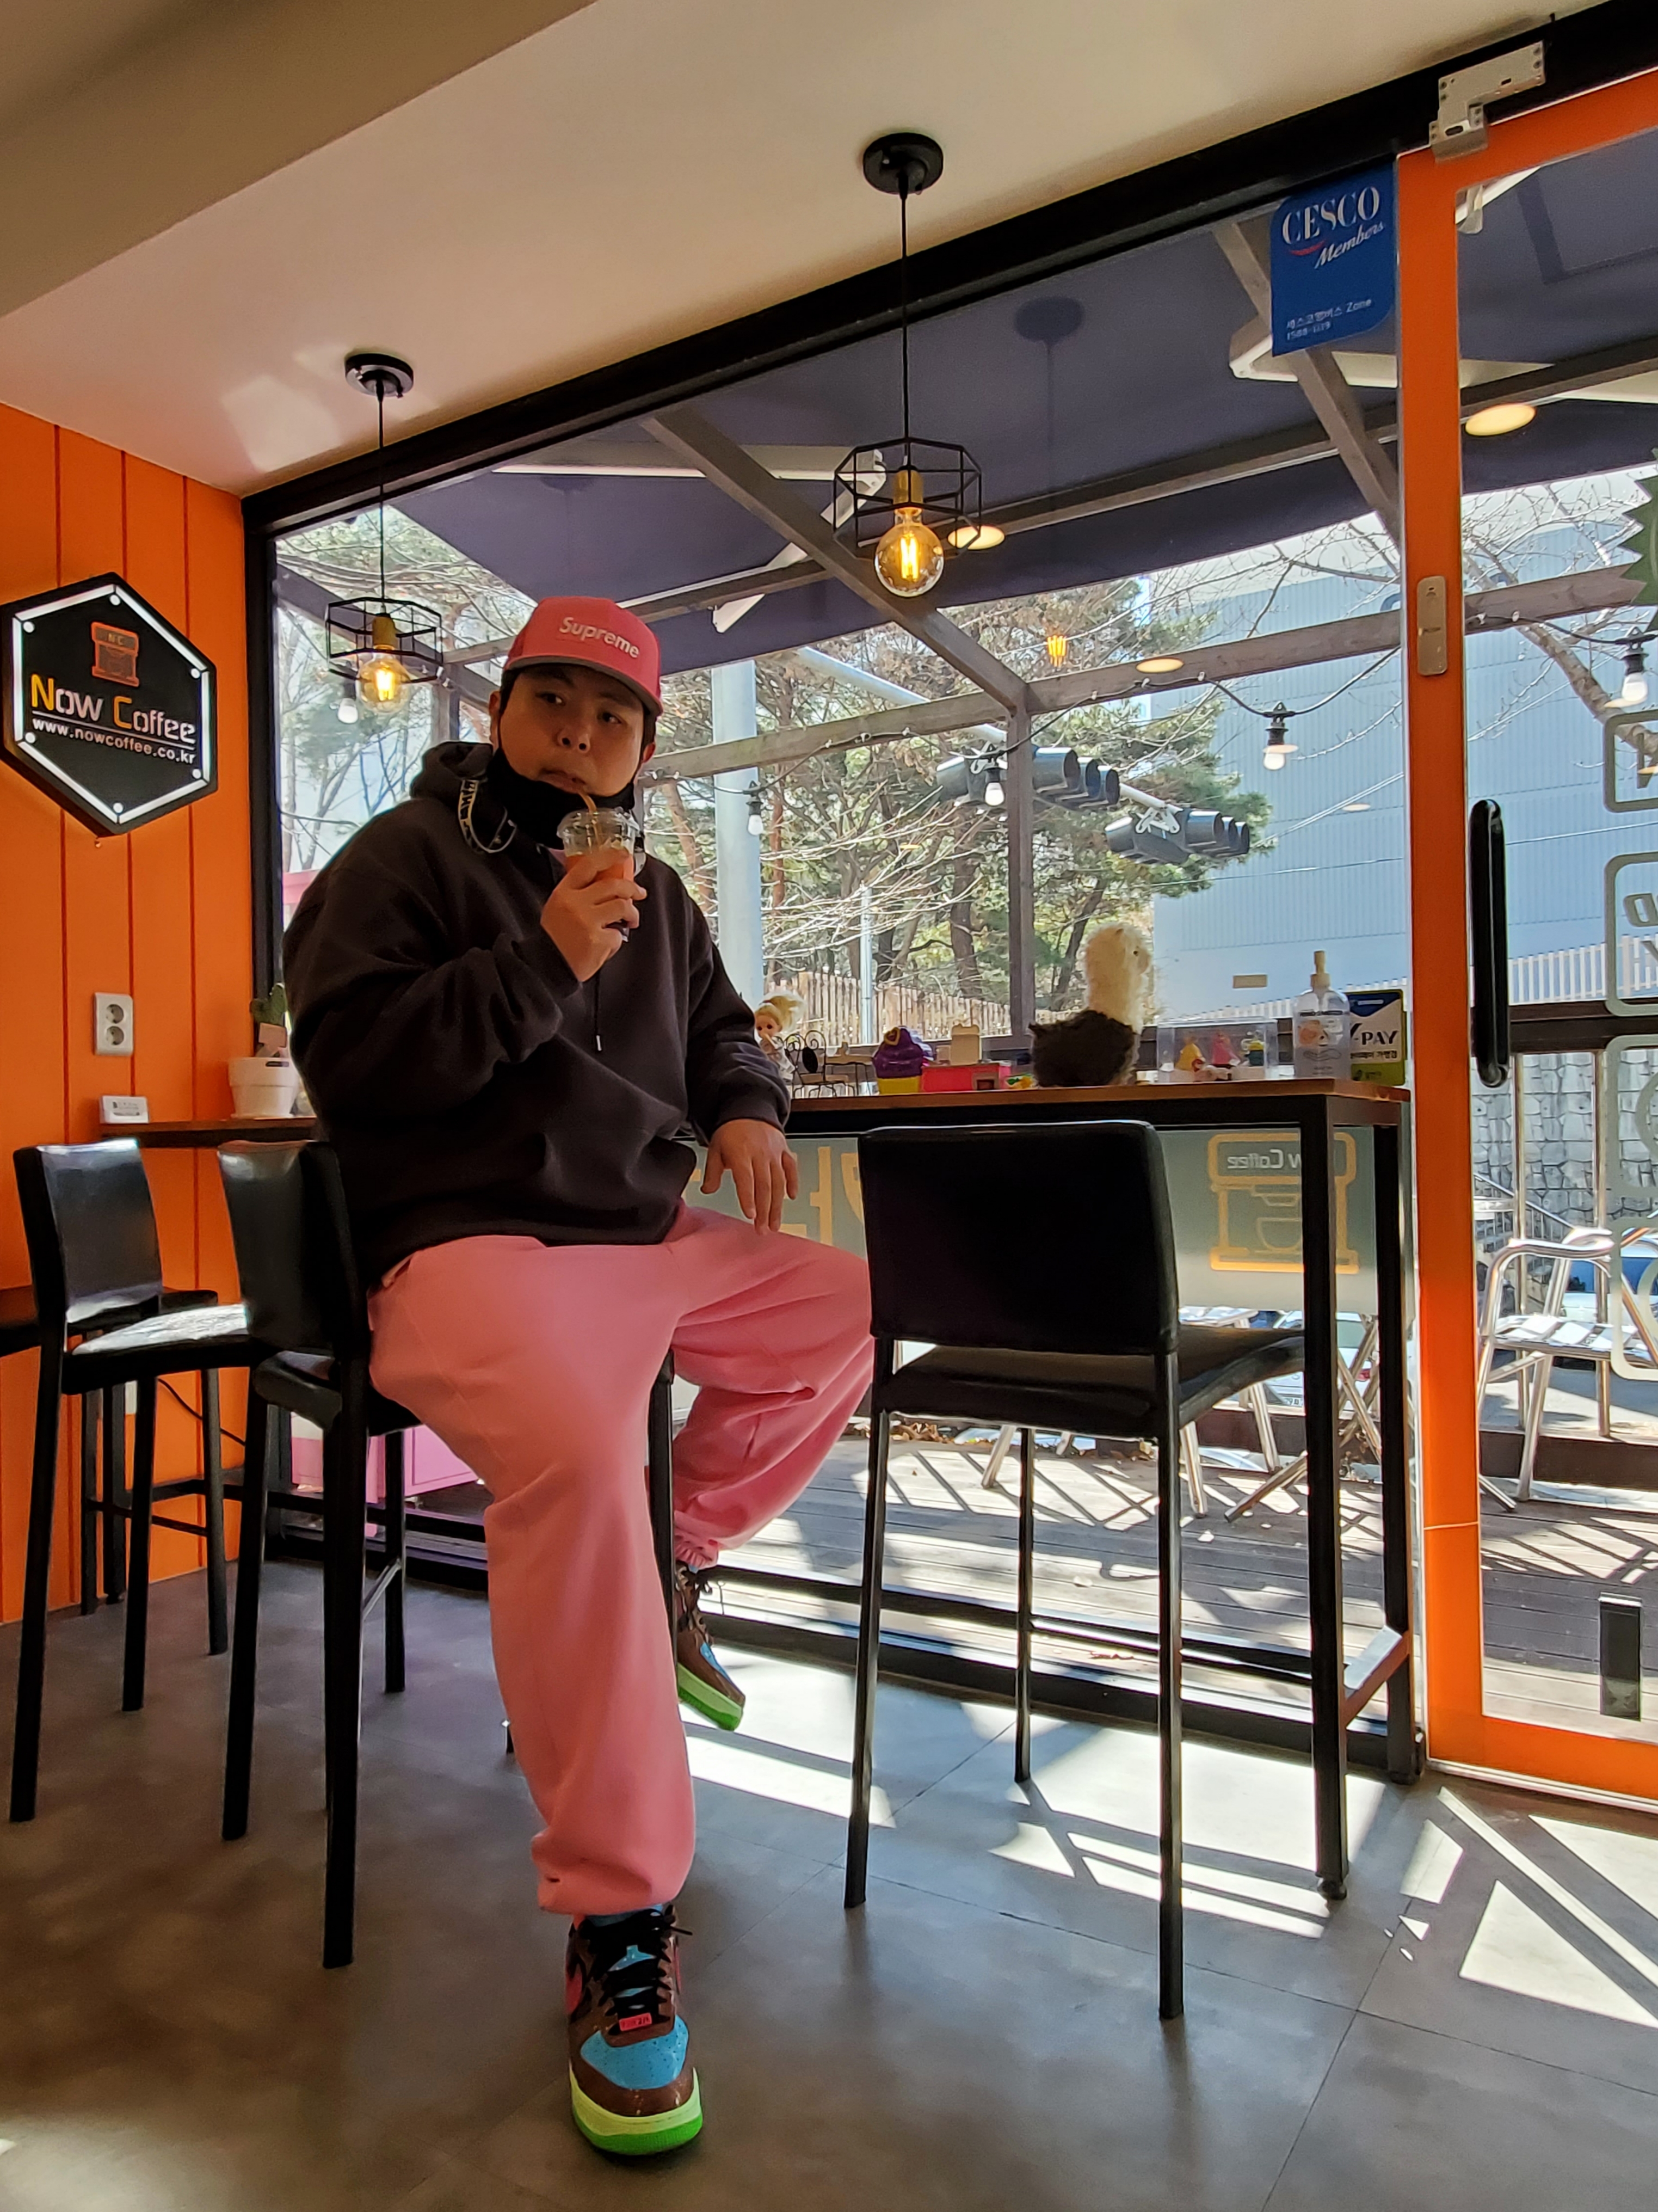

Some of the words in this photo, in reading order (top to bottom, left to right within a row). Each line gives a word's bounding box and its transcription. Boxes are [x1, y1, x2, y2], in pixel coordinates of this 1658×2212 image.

[1282, 186, 1380, 244] CESCO
[1314, 221, 1385, 269] Members
[1346, 299, 1372, 313] Zone
[559, 616, 640, 659] Supreme
[32, 717, 197, 764] www.nowcoffee.co.kr
[114, 695, 196, 745] Coffee
